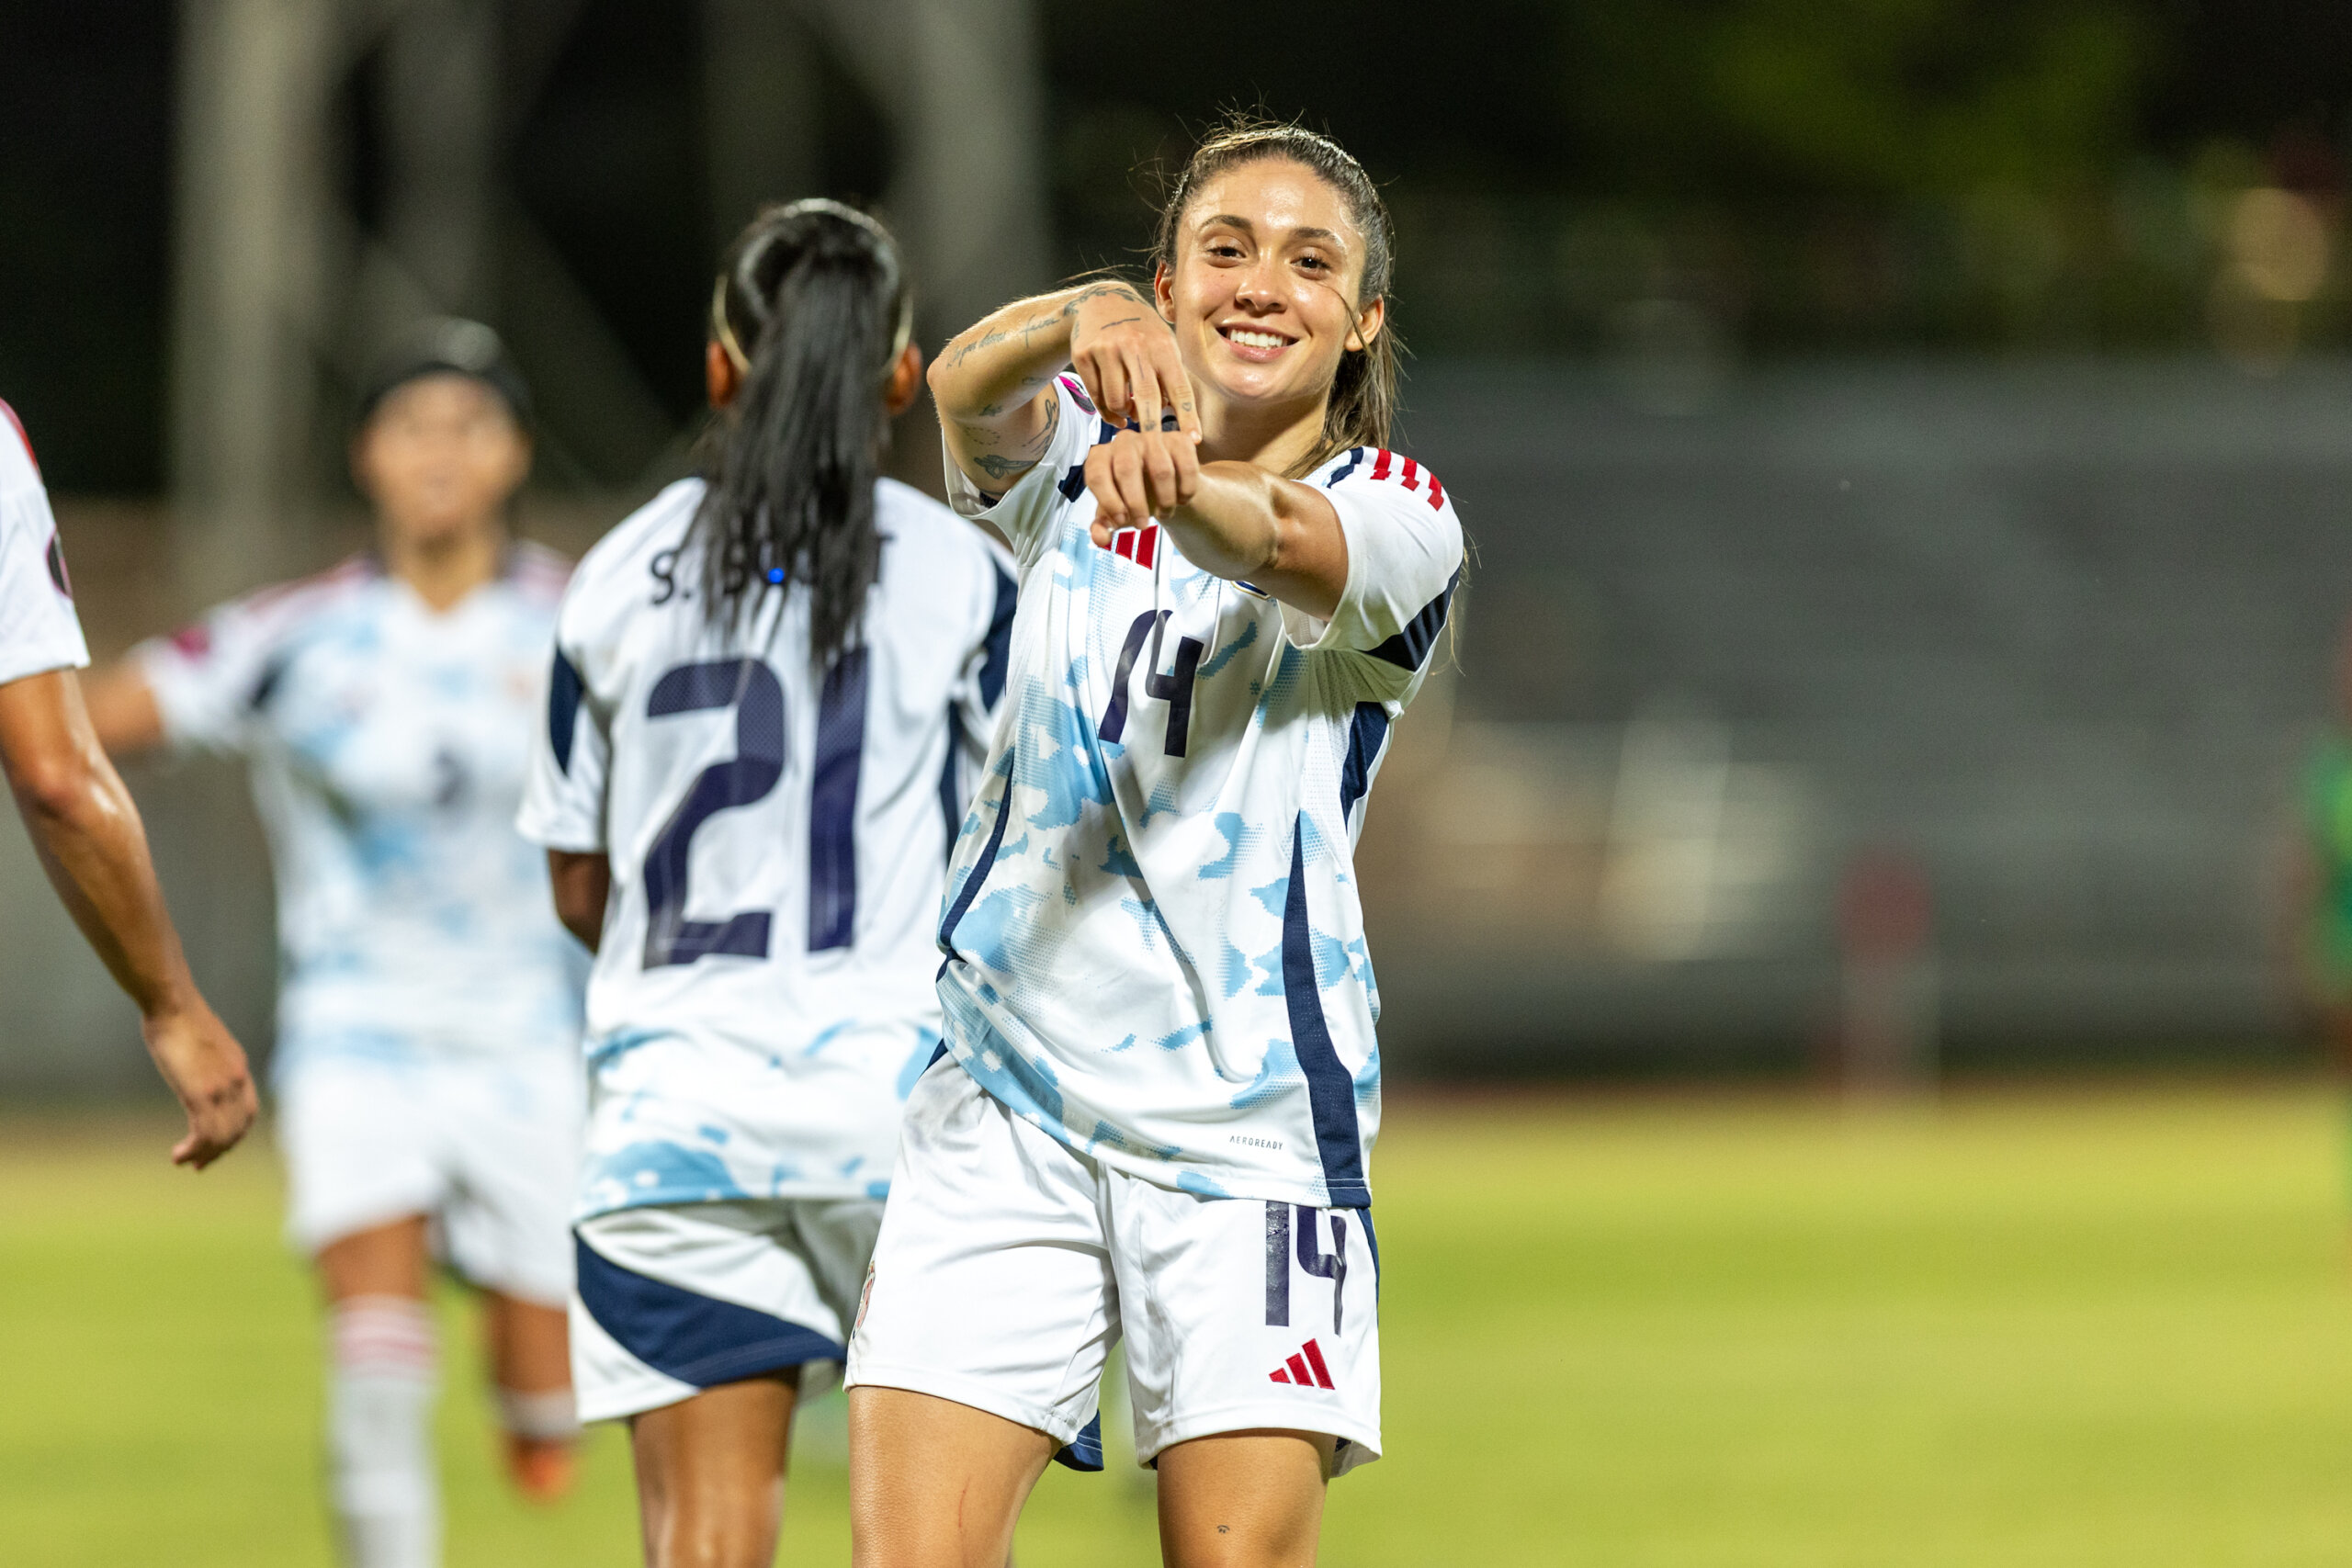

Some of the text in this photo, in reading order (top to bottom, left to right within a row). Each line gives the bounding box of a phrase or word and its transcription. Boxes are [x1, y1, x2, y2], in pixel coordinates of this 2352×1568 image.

[650, 549, 691, 605] S.
[1098, 608, 1204, 758] 14
[642, 643, 870, 971] 21
[1229, 1134, 1283, 1151] AEROREADY
[1265, 1200, 1346, 1337] 14
